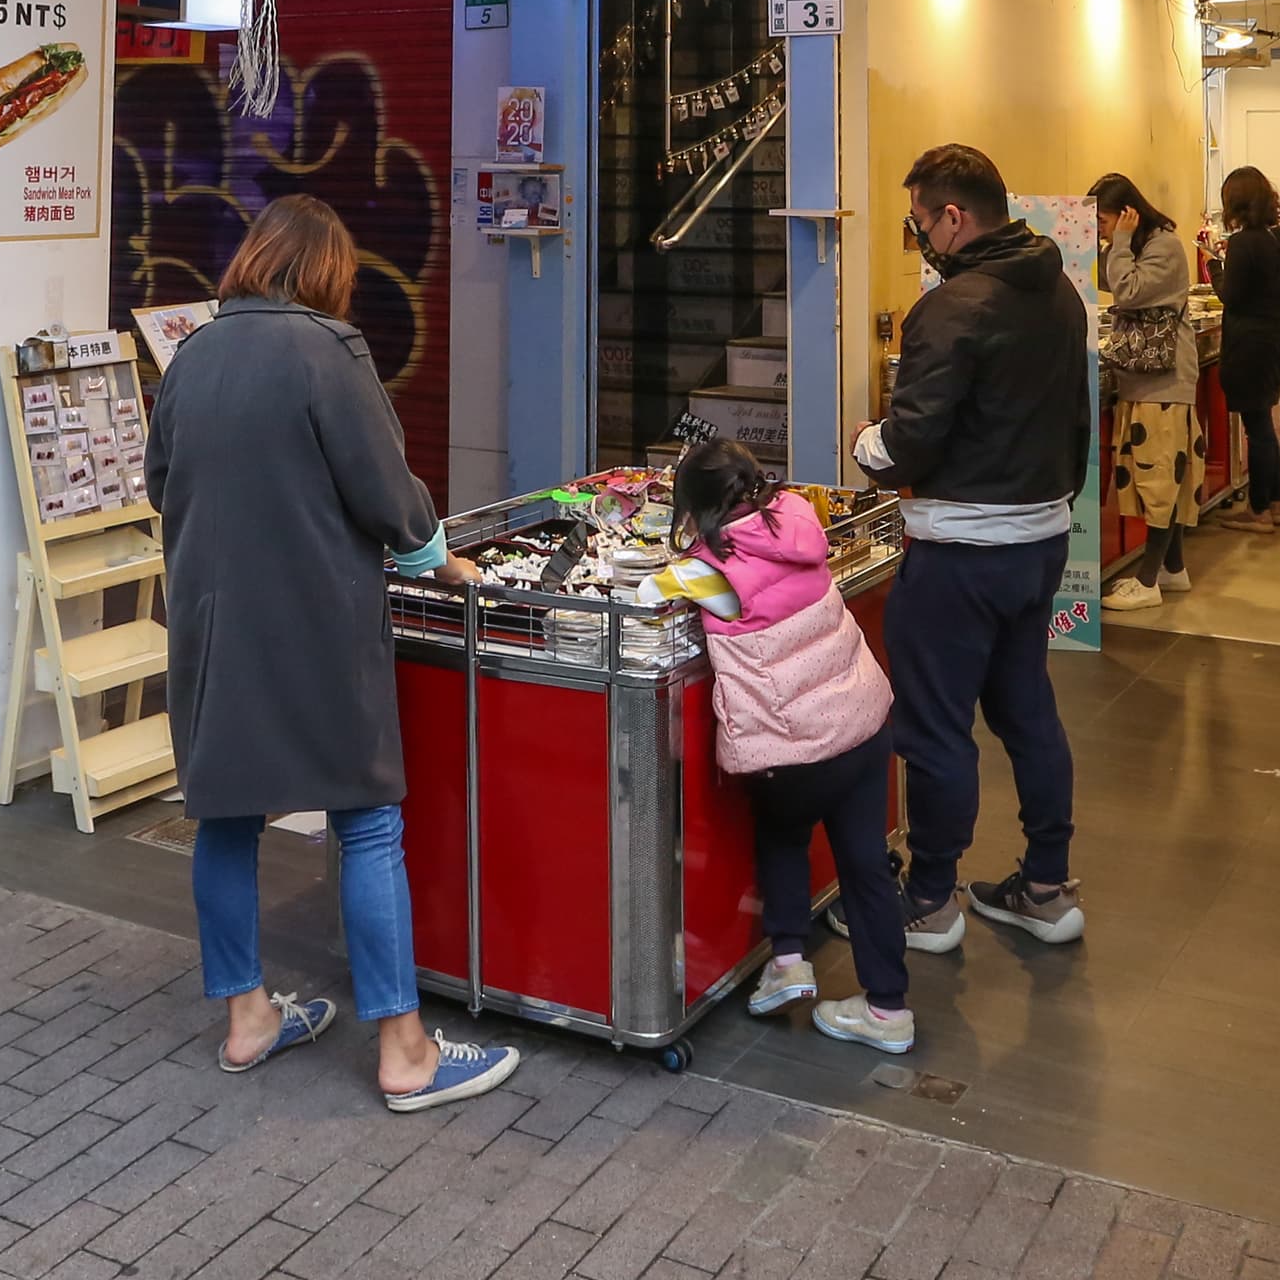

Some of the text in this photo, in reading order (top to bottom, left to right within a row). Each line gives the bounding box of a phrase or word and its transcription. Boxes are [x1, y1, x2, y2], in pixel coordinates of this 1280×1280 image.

[16, 2, 68, 29] NT$
[481, 8, 492, 24] 5
[802, 2, 819, 28] 3
[24, 166, 76, 183] 햄버거
[23, 186, 91, 201] Sandwich Meat Pork
[70, 341, 113, 359] 本月特惠
